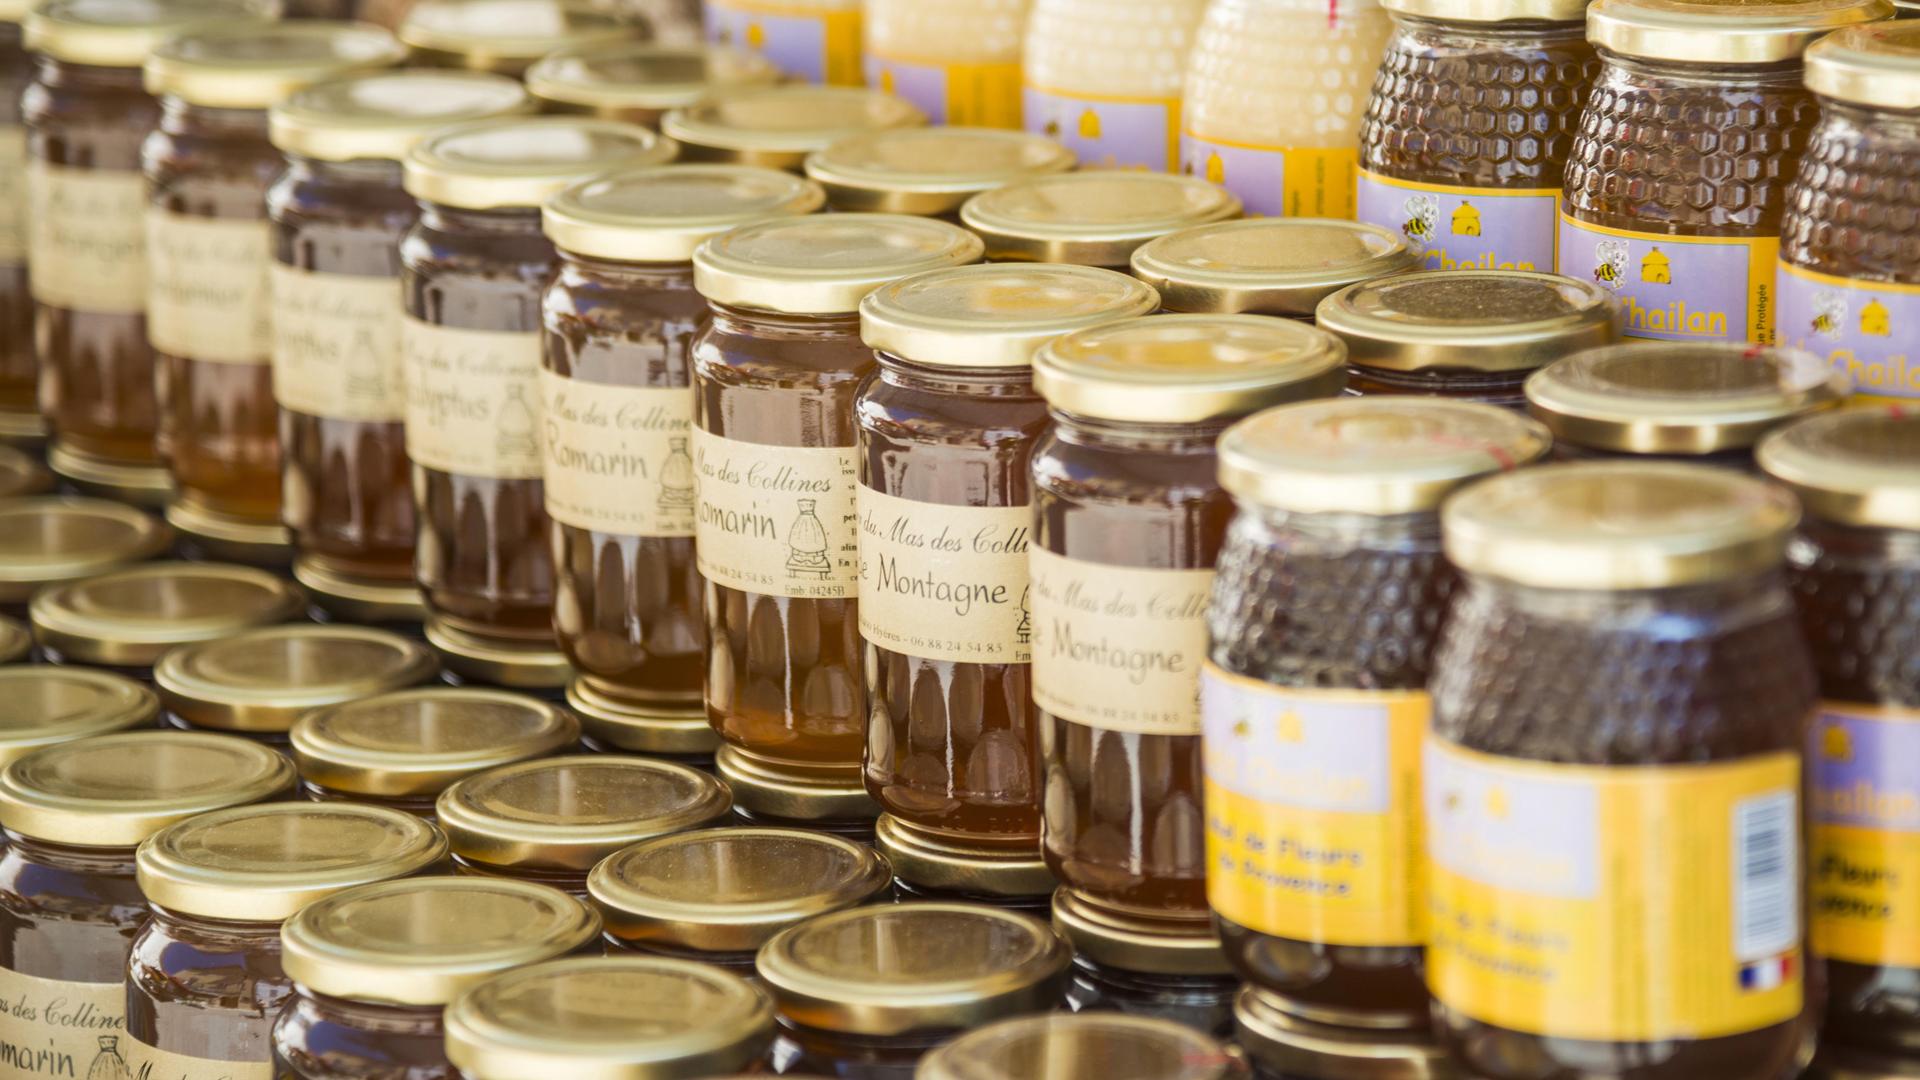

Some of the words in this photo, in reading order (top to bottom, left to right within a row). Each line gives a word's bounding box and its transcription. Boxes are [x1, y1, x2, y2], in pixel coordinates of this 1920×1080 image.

[1622, 296, 1728, 333] hailan
[718, 458, 740, 485] des
[747, 460, 832, 493] Collines
[879, 515, 925, 547] Mas
[930, 525, 963, 553] des
[877, 552, 1009, 617] Montagne
[927, 639, 942, 650] 88
[946, 641, 961, 651] 24
[986, 643, 1003, 653] 85
[1051, 616, 1186, 686] Montagne
[1278, 837, 1364, 867] Fleurs
[1243, 857, 1350, 894] Provence
[12, 994, 37, 1021] des
